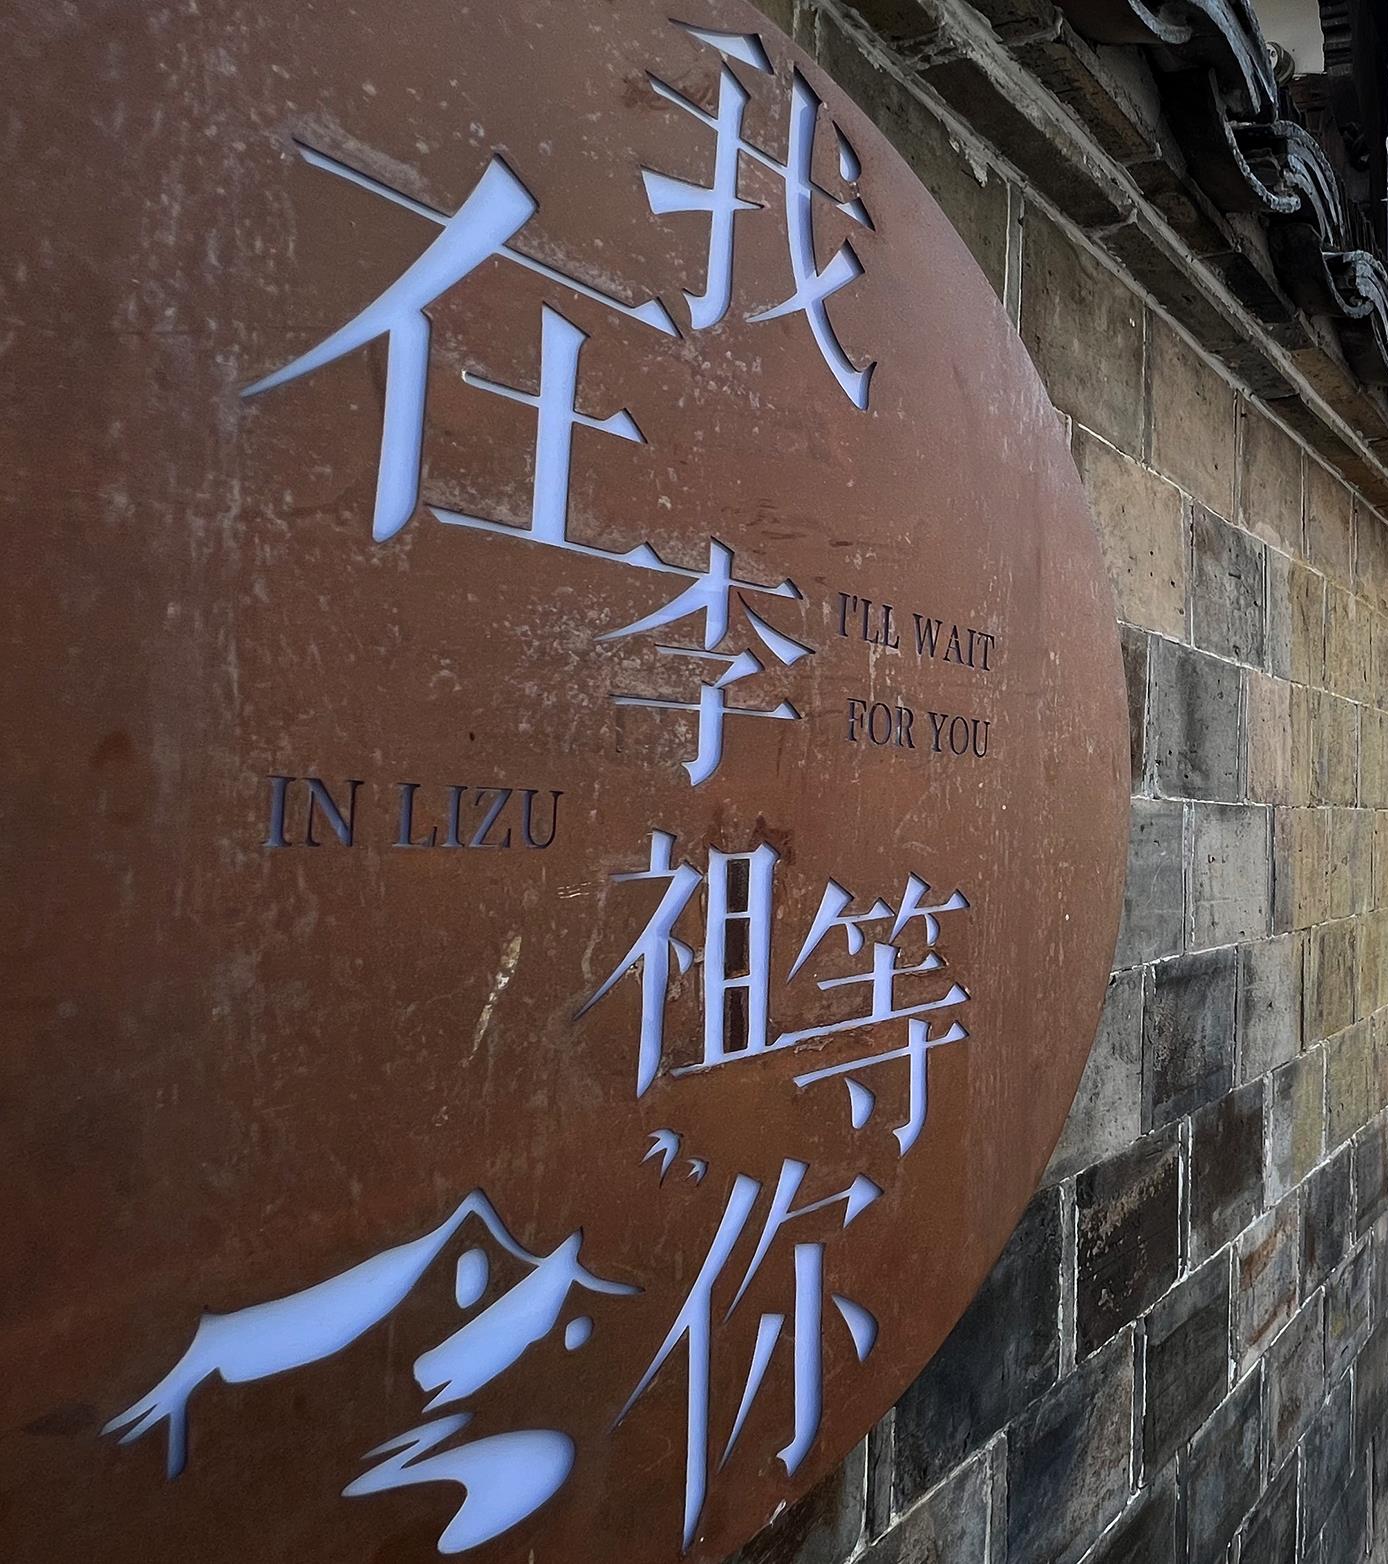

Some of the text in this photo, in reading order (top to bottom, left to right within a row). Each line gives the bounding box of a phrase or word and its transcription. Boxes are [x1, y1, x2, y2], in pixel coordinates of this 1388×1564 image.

[837, 591, 996, 672] I'LL WAIT
[847, 697, 991, 759] FOR YOU
[259, 775, 565, 850] IN LIZU
